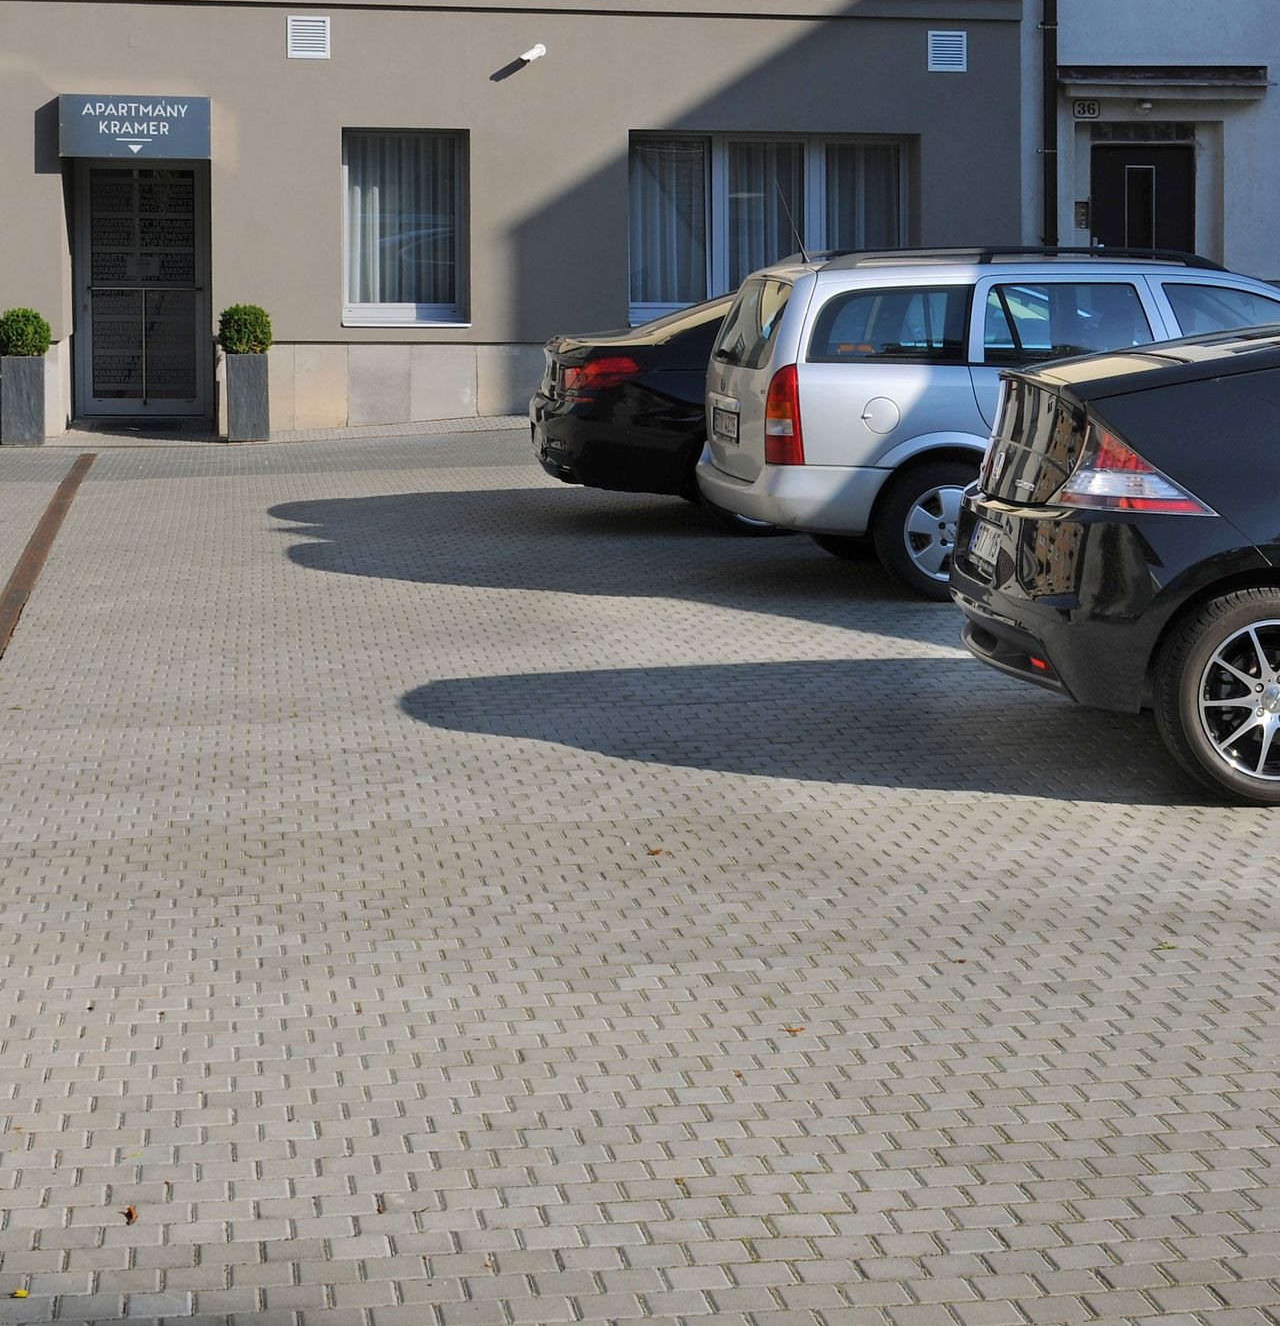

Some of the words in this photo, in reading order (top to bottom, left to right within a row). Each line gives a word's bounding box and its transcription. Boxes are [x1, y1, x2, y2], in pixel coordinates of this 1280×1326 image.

[81, 100, 188, 117] APARTMÁNY
[1077, 102, 1096, 115] 36
[99, 121, 169, 135] KRAMER
